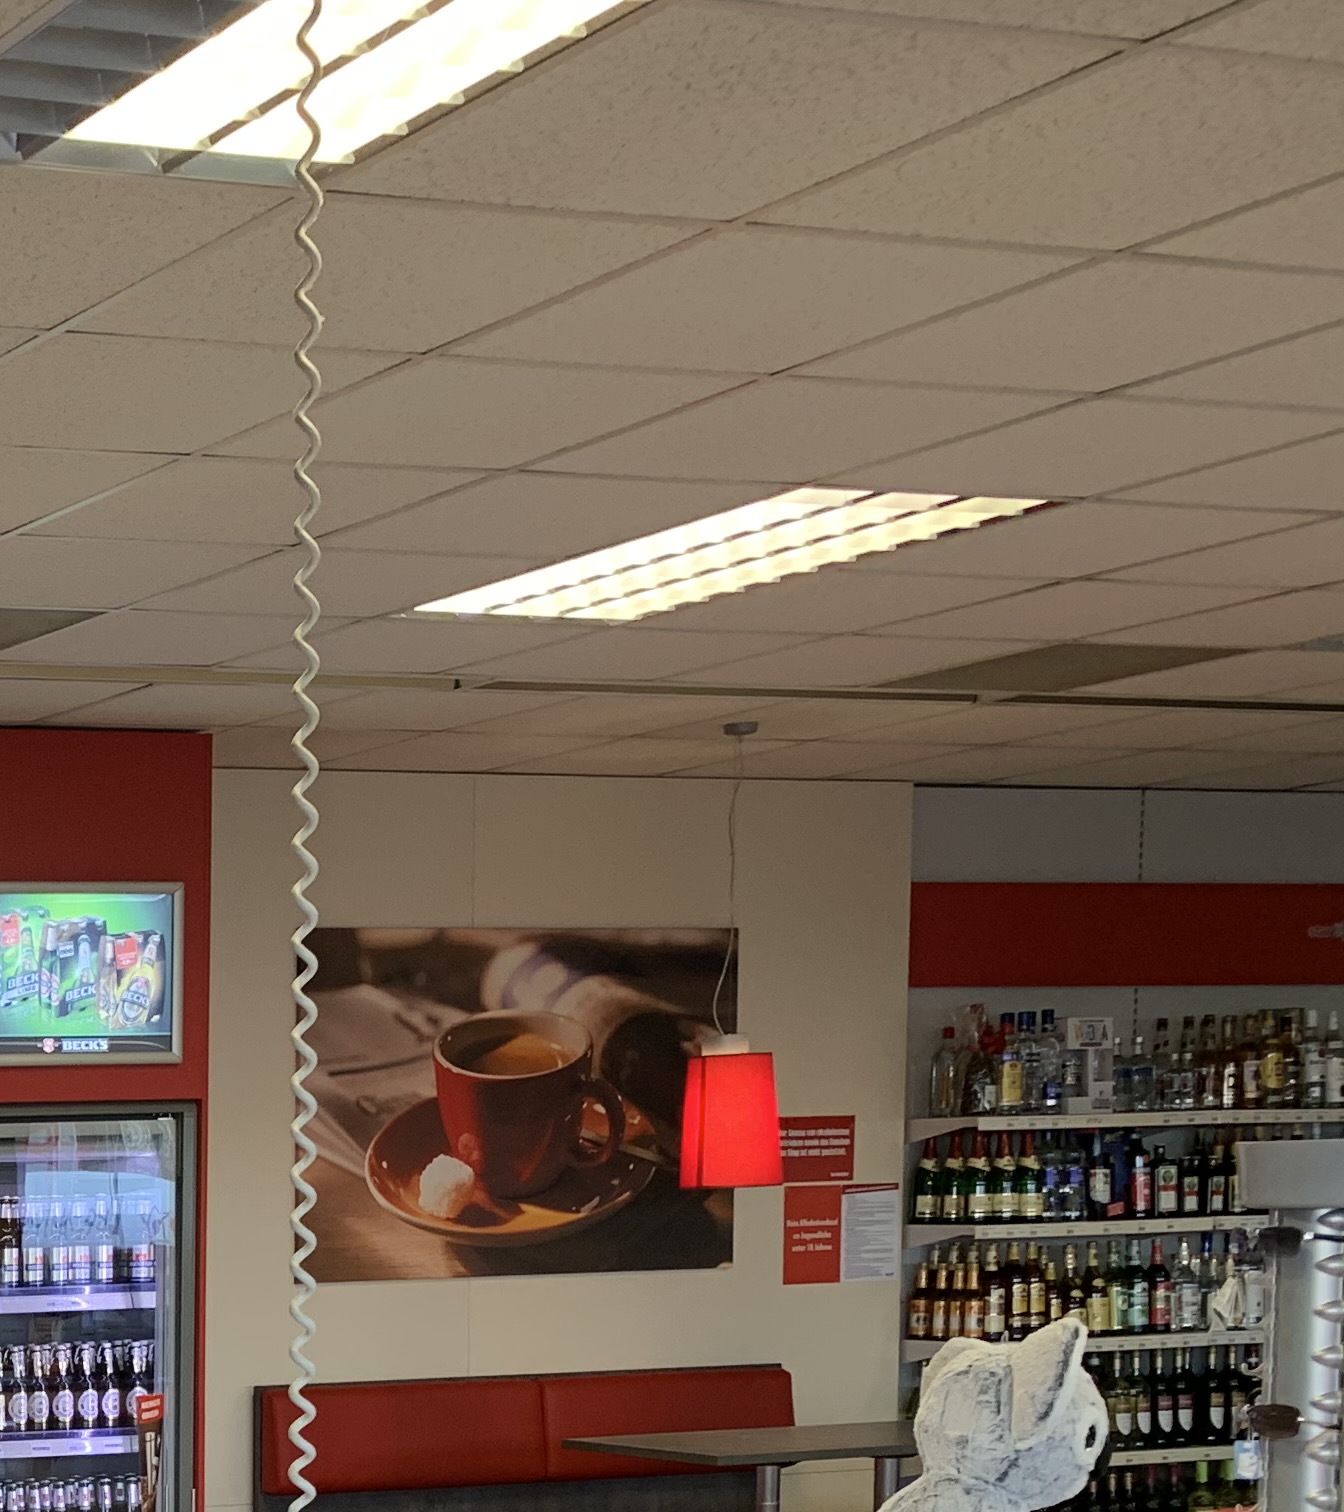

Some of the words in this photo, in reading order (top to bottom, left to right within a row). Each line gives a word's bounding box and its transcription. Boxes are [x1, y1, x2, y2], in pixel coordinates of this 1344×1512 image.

[7, 973, 39, 990] BECK
[65, 985, 96, 1002] BECK
[62, 1038, 109, 1051] BECK'S
